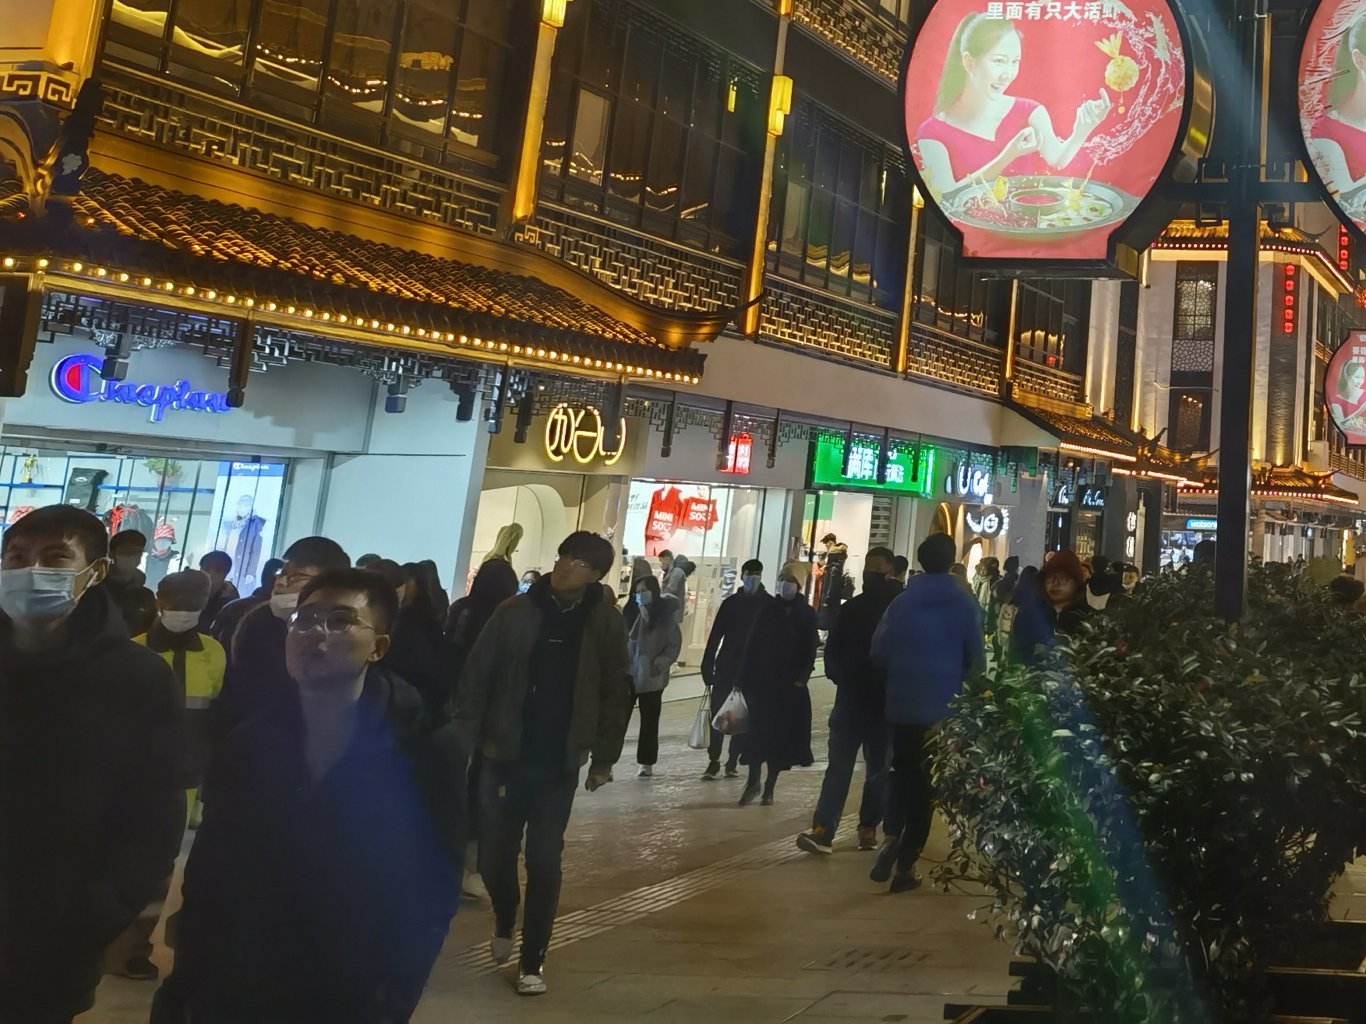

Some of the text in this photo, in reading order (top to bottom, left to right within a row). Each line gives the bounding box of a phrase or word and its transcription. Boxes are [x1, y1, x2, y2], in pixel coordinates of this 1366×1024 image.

[985, 1, 1119, 20] 里面有只大活虾
[653, 510, 673, 521] MINI
